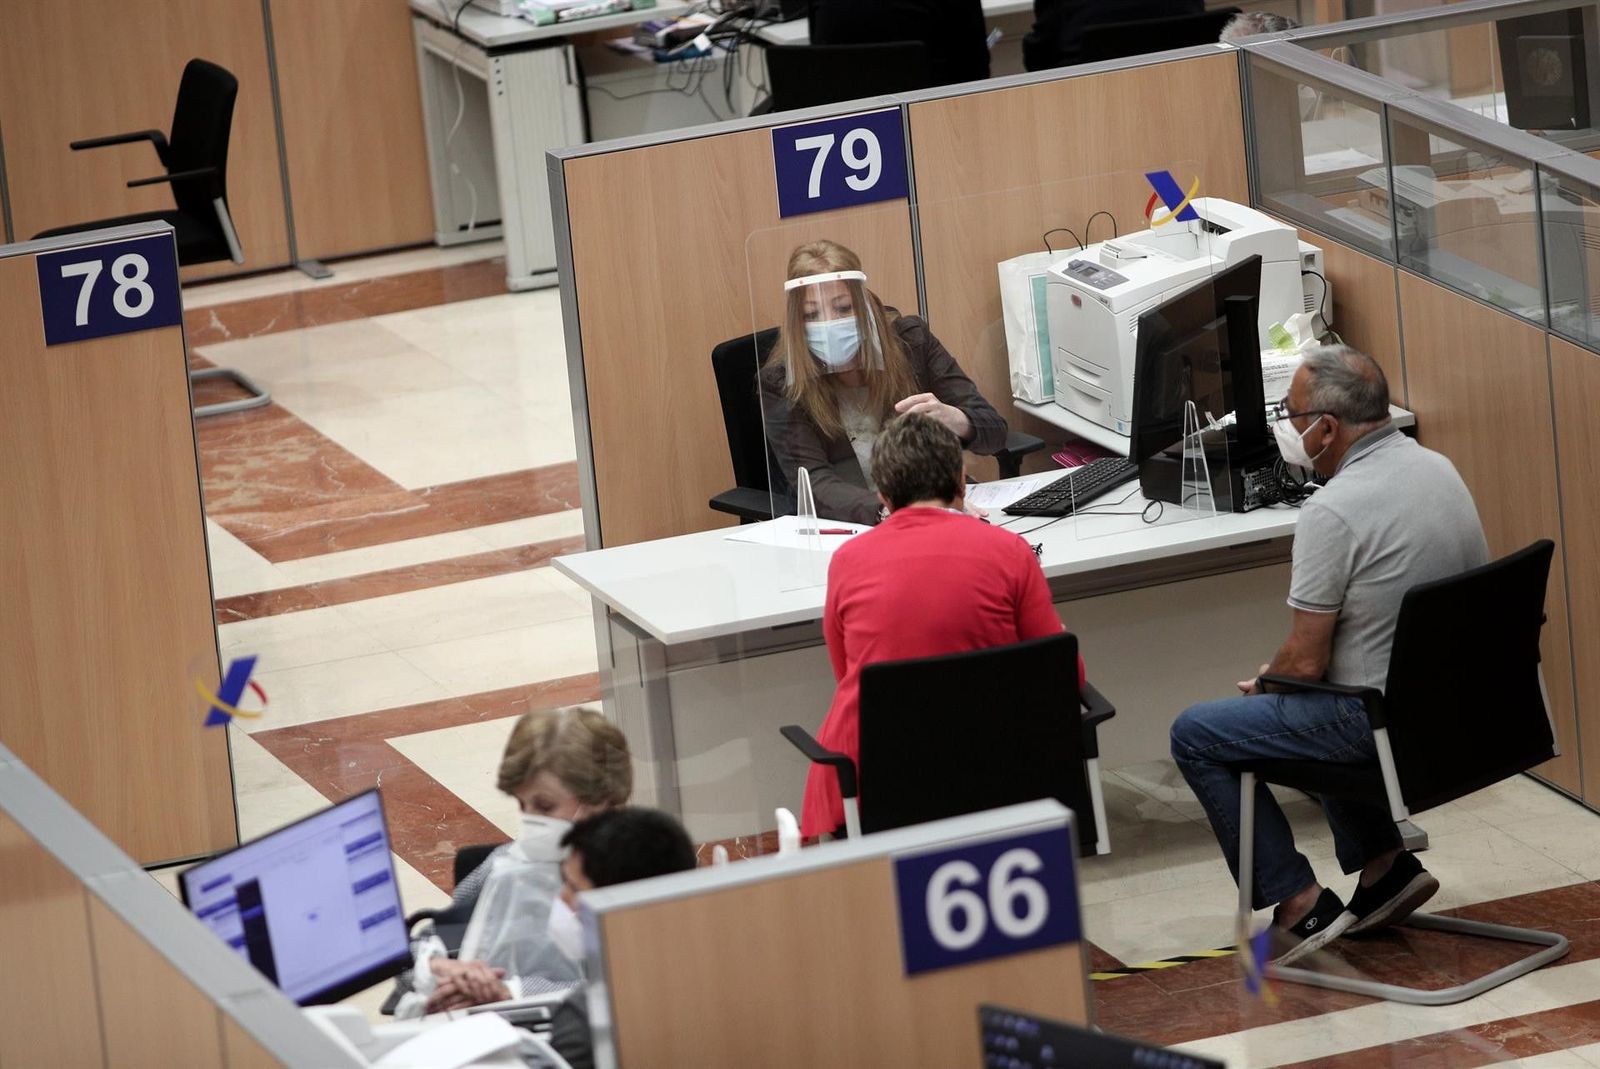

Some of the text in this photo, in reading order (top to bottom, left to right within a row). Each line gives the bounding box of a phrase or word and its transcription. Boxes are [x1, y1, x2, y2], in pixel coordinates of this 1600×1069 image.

[795, 127, 882, 198] 79
[61, 253, 154, 326] 78
[926, 848, 1048, 950] 66
